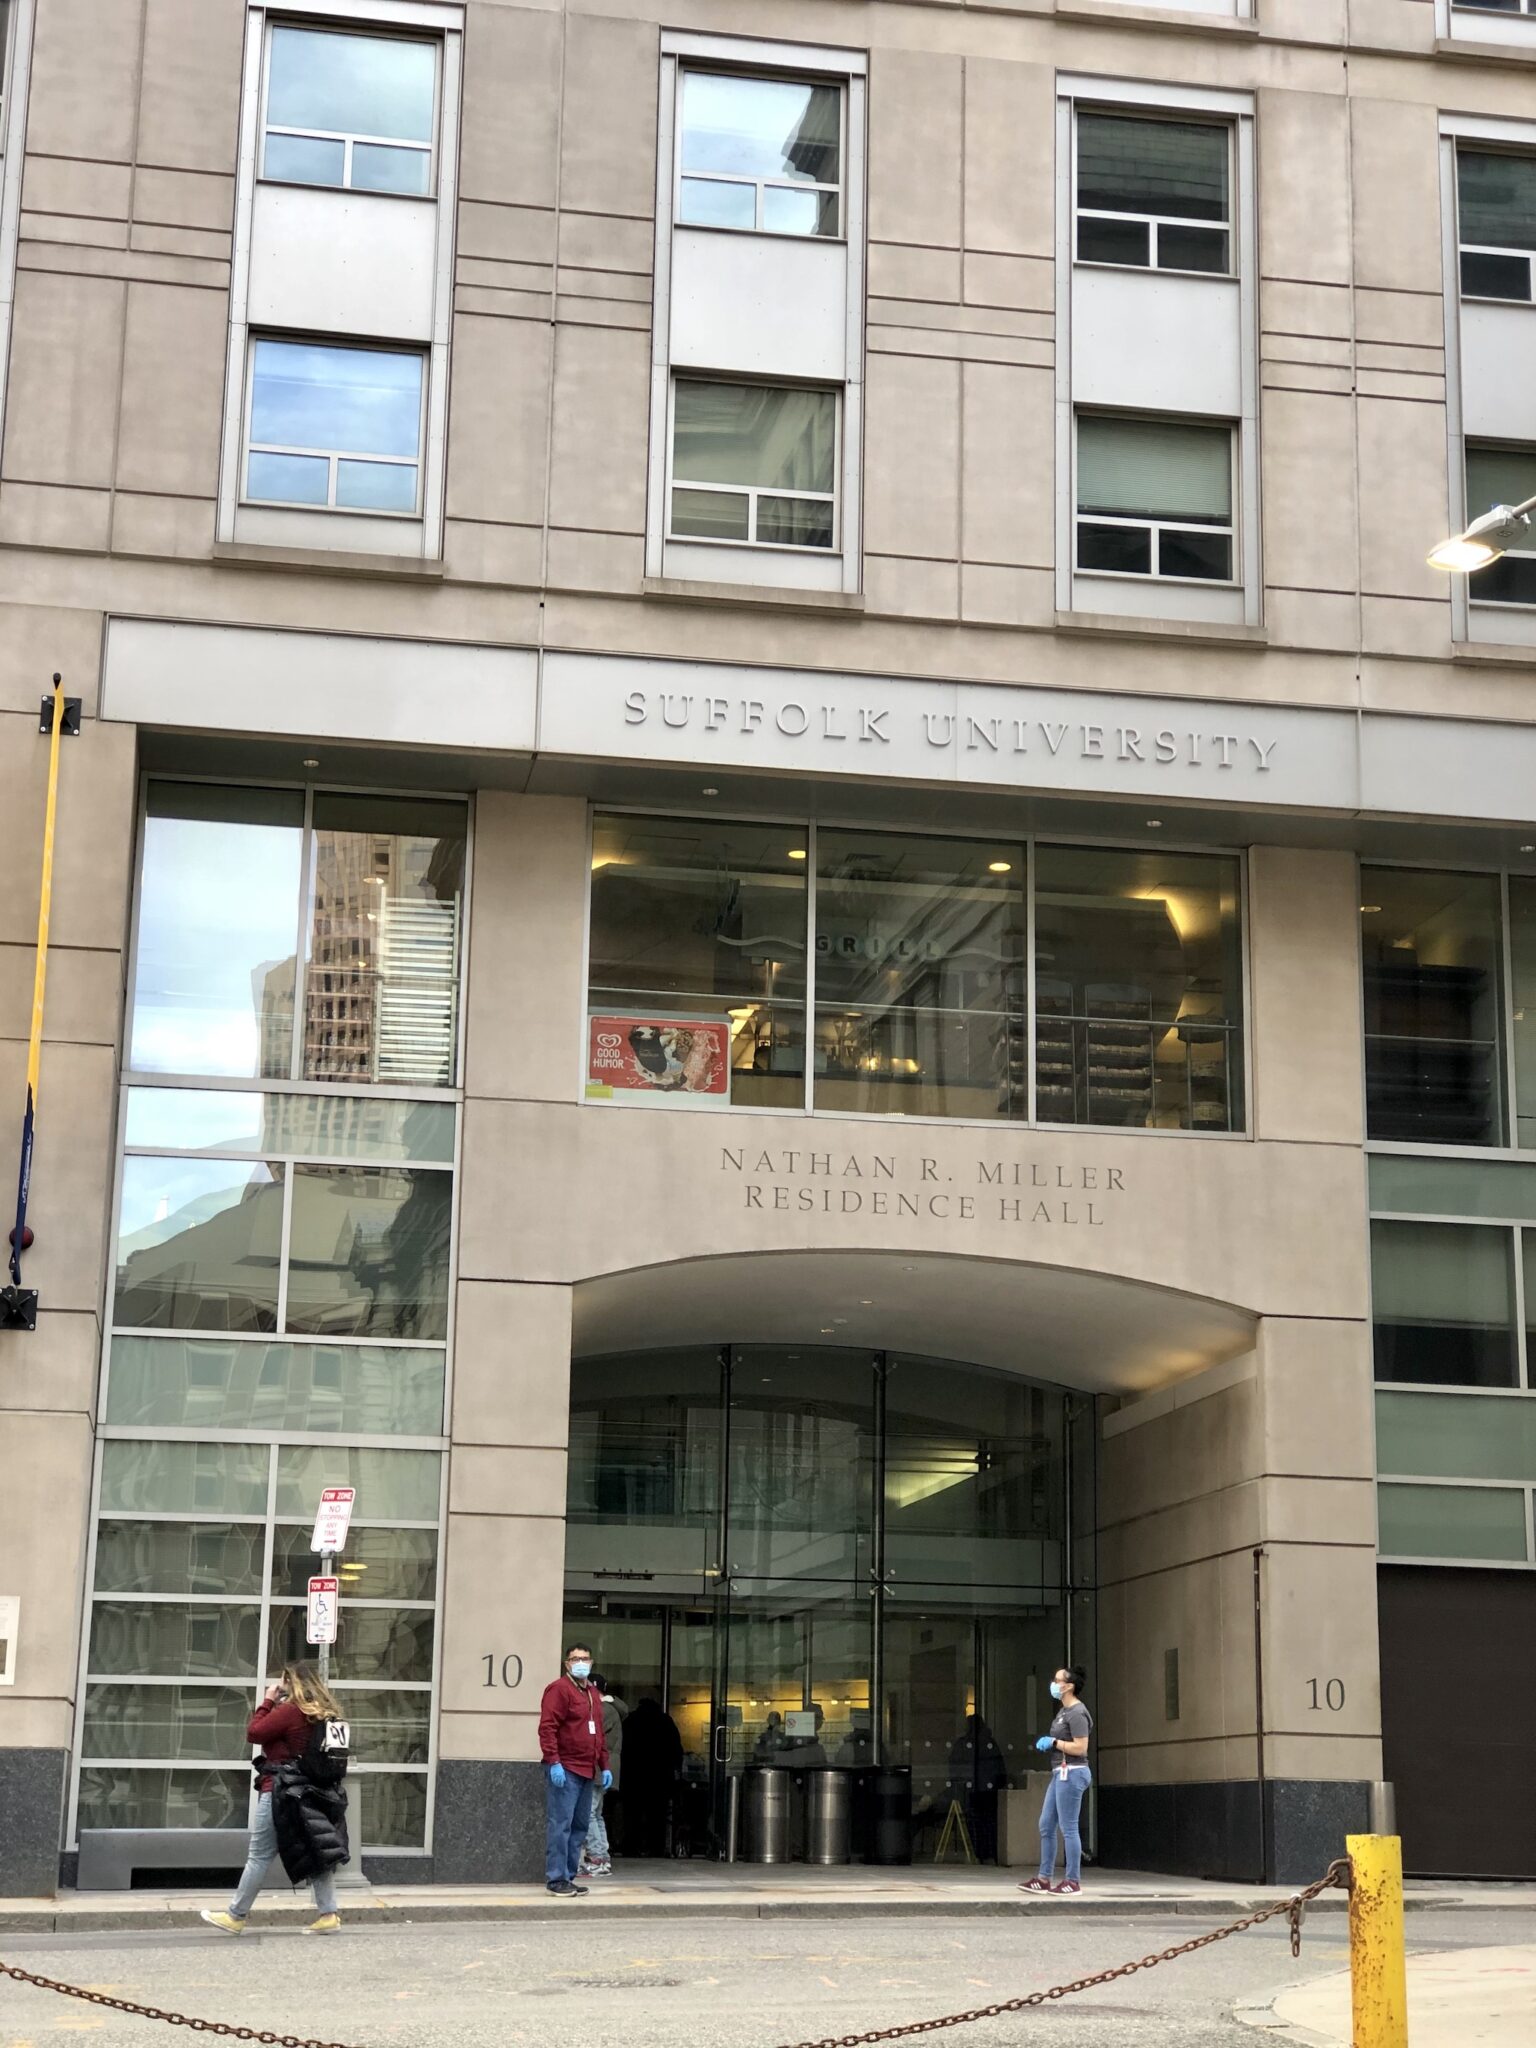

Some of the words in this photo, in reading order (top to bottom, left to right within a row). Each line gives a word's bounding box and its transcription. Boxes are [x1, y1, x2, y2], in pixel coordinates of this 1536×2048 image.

[624, 690, 891, 742] SUFFOLK
[923, 712, 1278, 771] UNIVERSITY
[815, 935, 937, 959] GRILL
[593, 1058, 624, 1069] HUMOR
[597, 1048, 620, 1058] GOOD
[720, 1147, 897, 1180] NATHAN
[920, 1158, 953, 1182] R.
[977, 1160, 1127, 1191] MILLER
[743, 1185, 976, 1220] RESIDENCE
[999, 1199, 1105, 1226] HALL
[323, 1492, 336, 1500] TOW
[337, 1492, 353, 1500] ZONE
[329, 1505, 341, 1513] NO
[311, 1582, 322, 1590] TOW
[323, 1582, 336, 1590] ZONE
[482, 1654, 523, 1688] 10
[1306, 1678, 1345, 1711] 10
